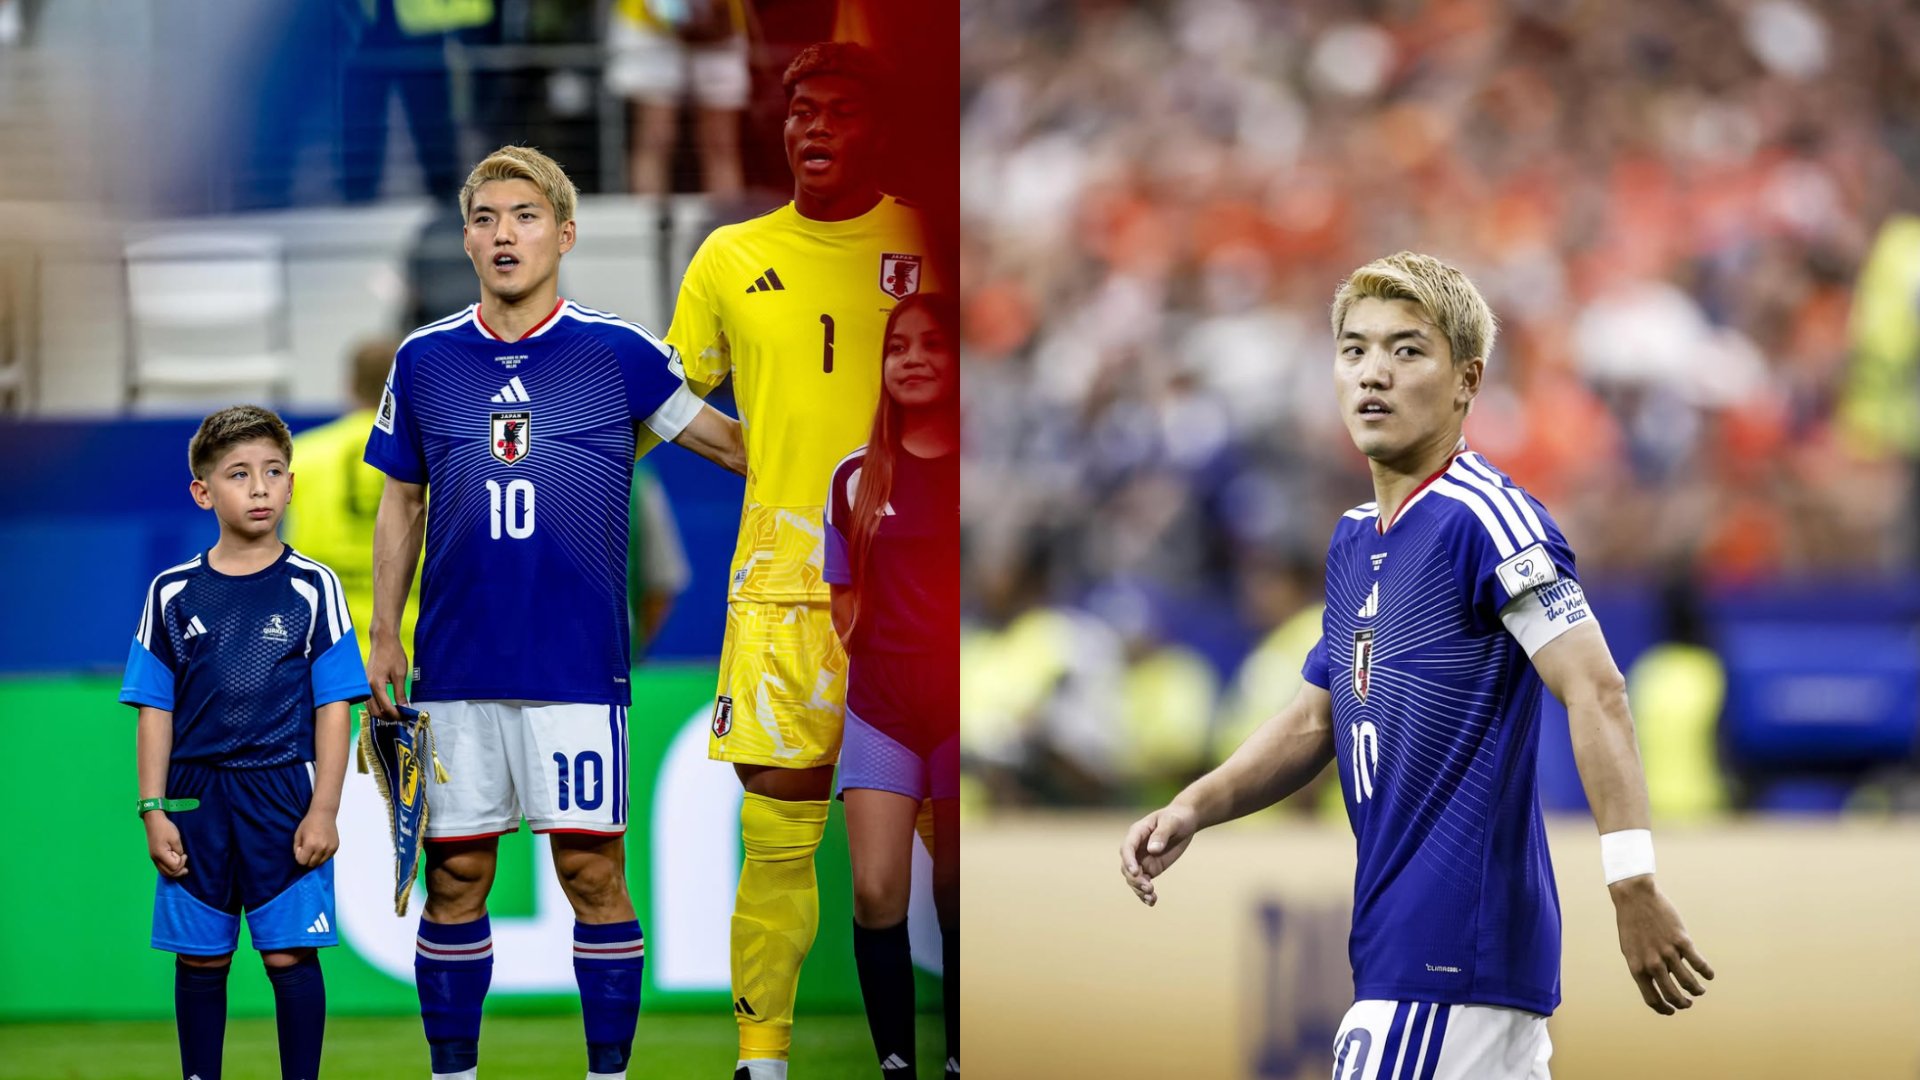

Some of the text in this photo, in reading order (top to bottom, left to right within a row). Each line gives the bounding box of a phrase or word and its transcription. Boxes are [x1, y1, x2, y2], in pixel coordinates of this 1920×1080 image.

[819, 313, 835, 374] 1
[501, 448, 519, 457] JFA
[486, 479, 536, 540] 10
[1544, 606, 1565, 622] the
[1568, 610, 1587, 623] FIFA
[553, 750, 604, 812] 10
[1352, 721, 1379, 804] 10
